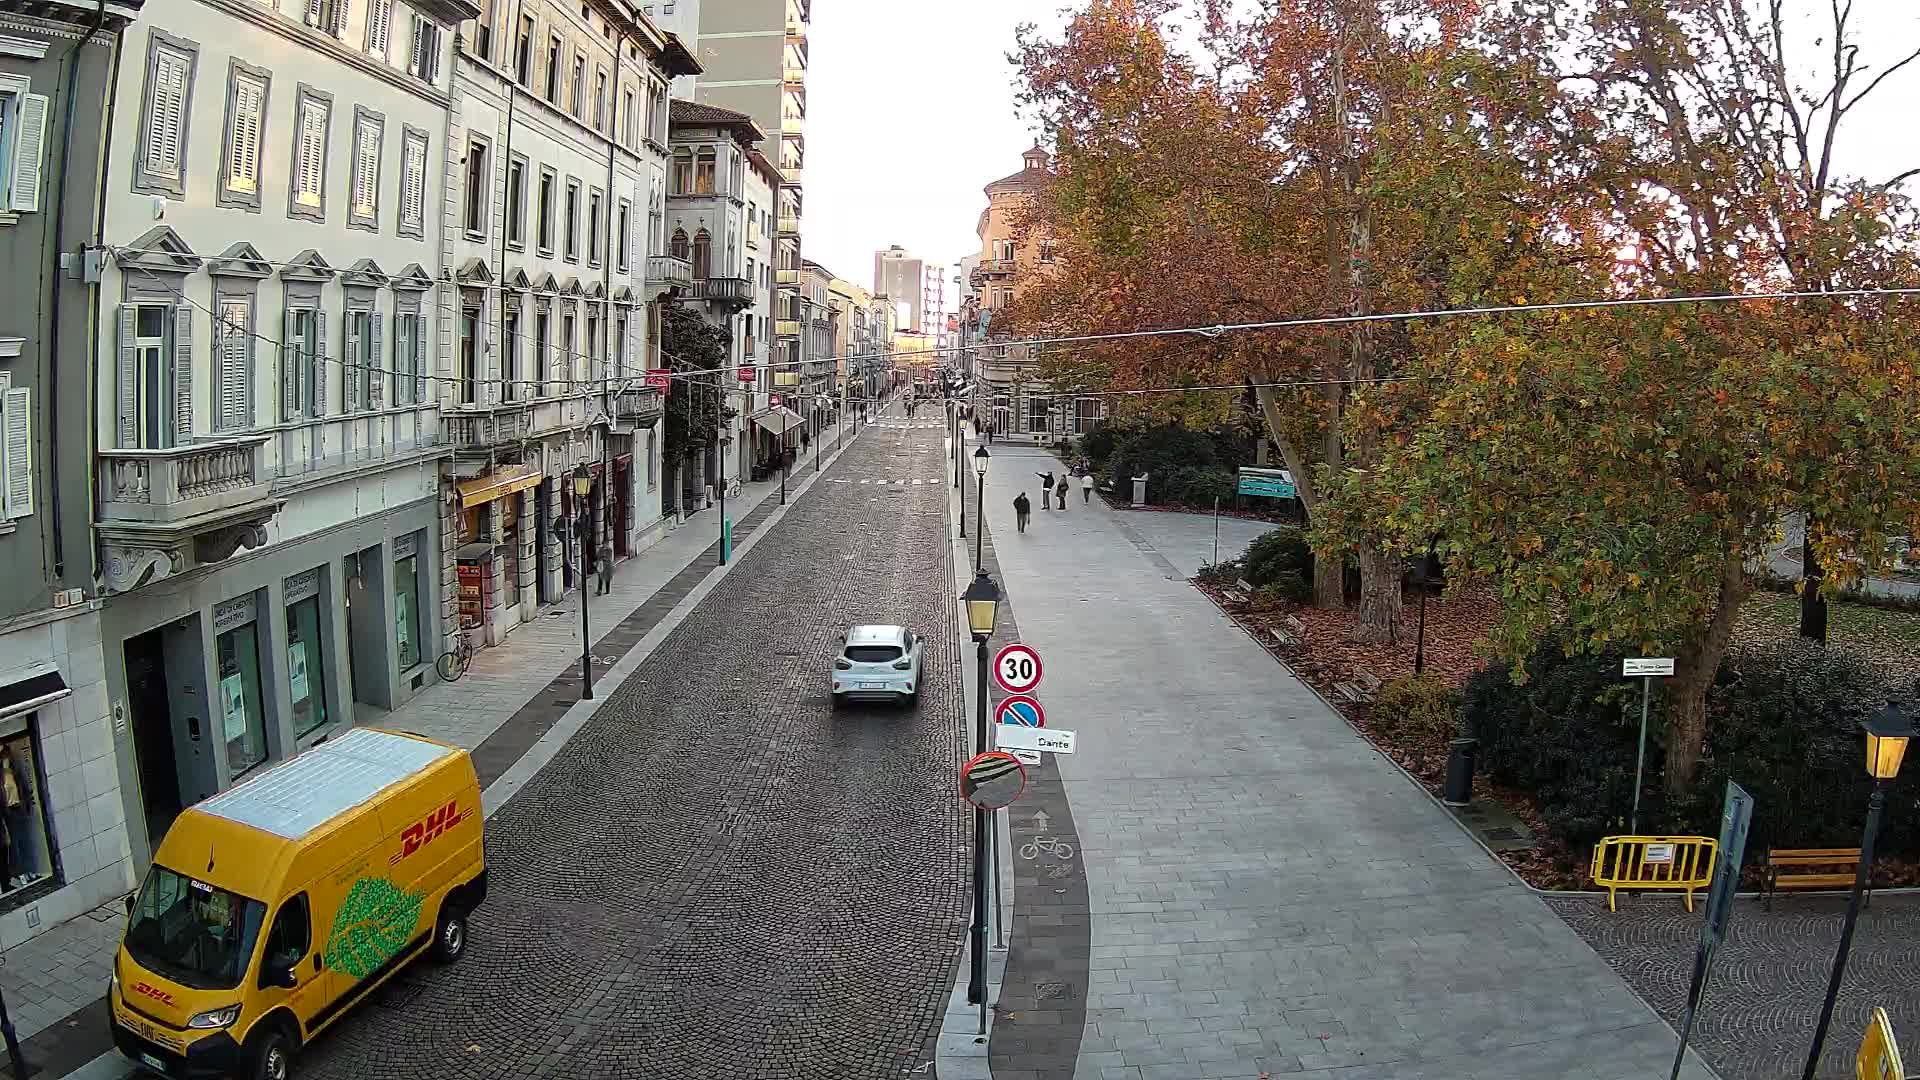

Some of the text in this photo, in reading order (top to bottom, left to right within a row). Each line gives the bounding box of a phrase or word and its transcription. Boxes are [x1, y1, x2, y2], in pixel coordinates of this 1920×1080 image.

[1005, 658, 1033, 680] 30
[1038, 737, 1069, 749] Dante
[401, 800, 463, 859] DHL
[136, 981, 175, 1007] DHL
